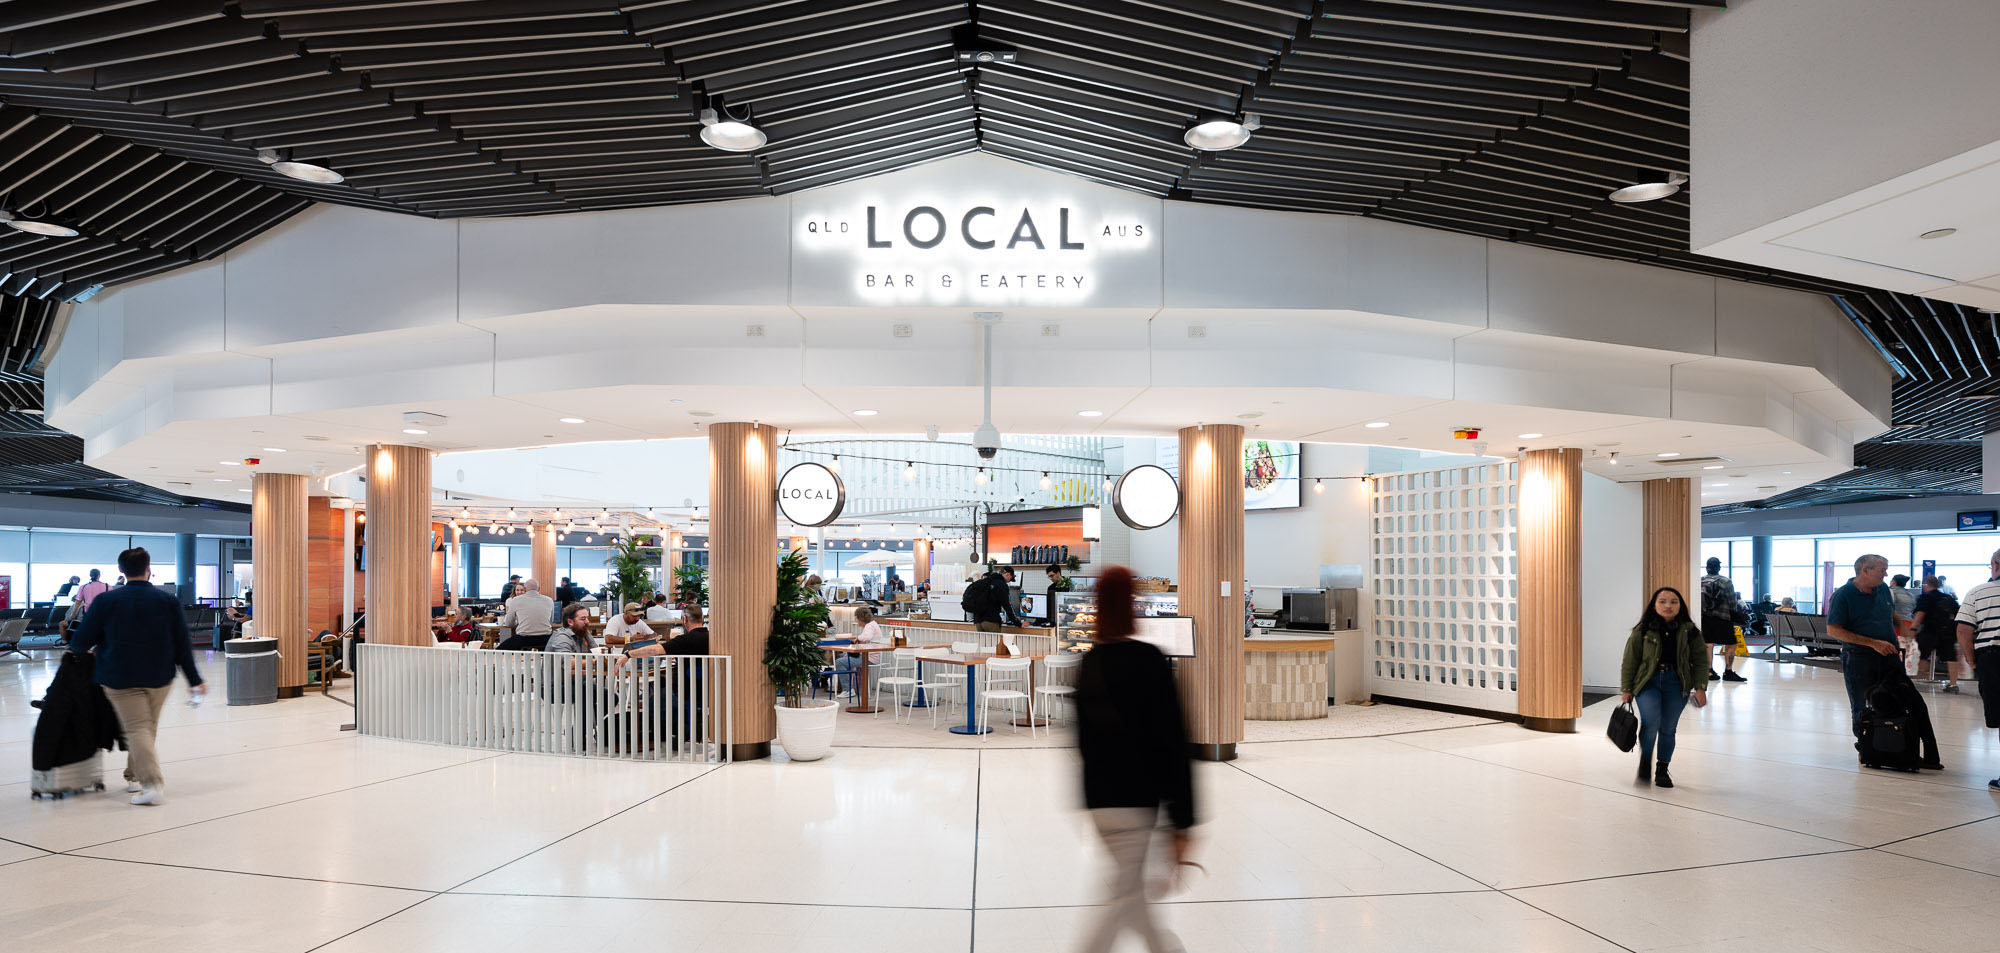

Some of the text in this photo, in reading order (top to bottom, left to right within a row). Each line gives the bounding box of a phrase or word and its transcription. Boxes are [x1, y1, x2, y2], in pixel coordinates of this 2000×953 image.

[808, 206, 1144, 250] QLD LOCAL AUS
[866, 274, 1084, 289] BAR & EATERY
[782, 488, 833, 500] LOCAL
